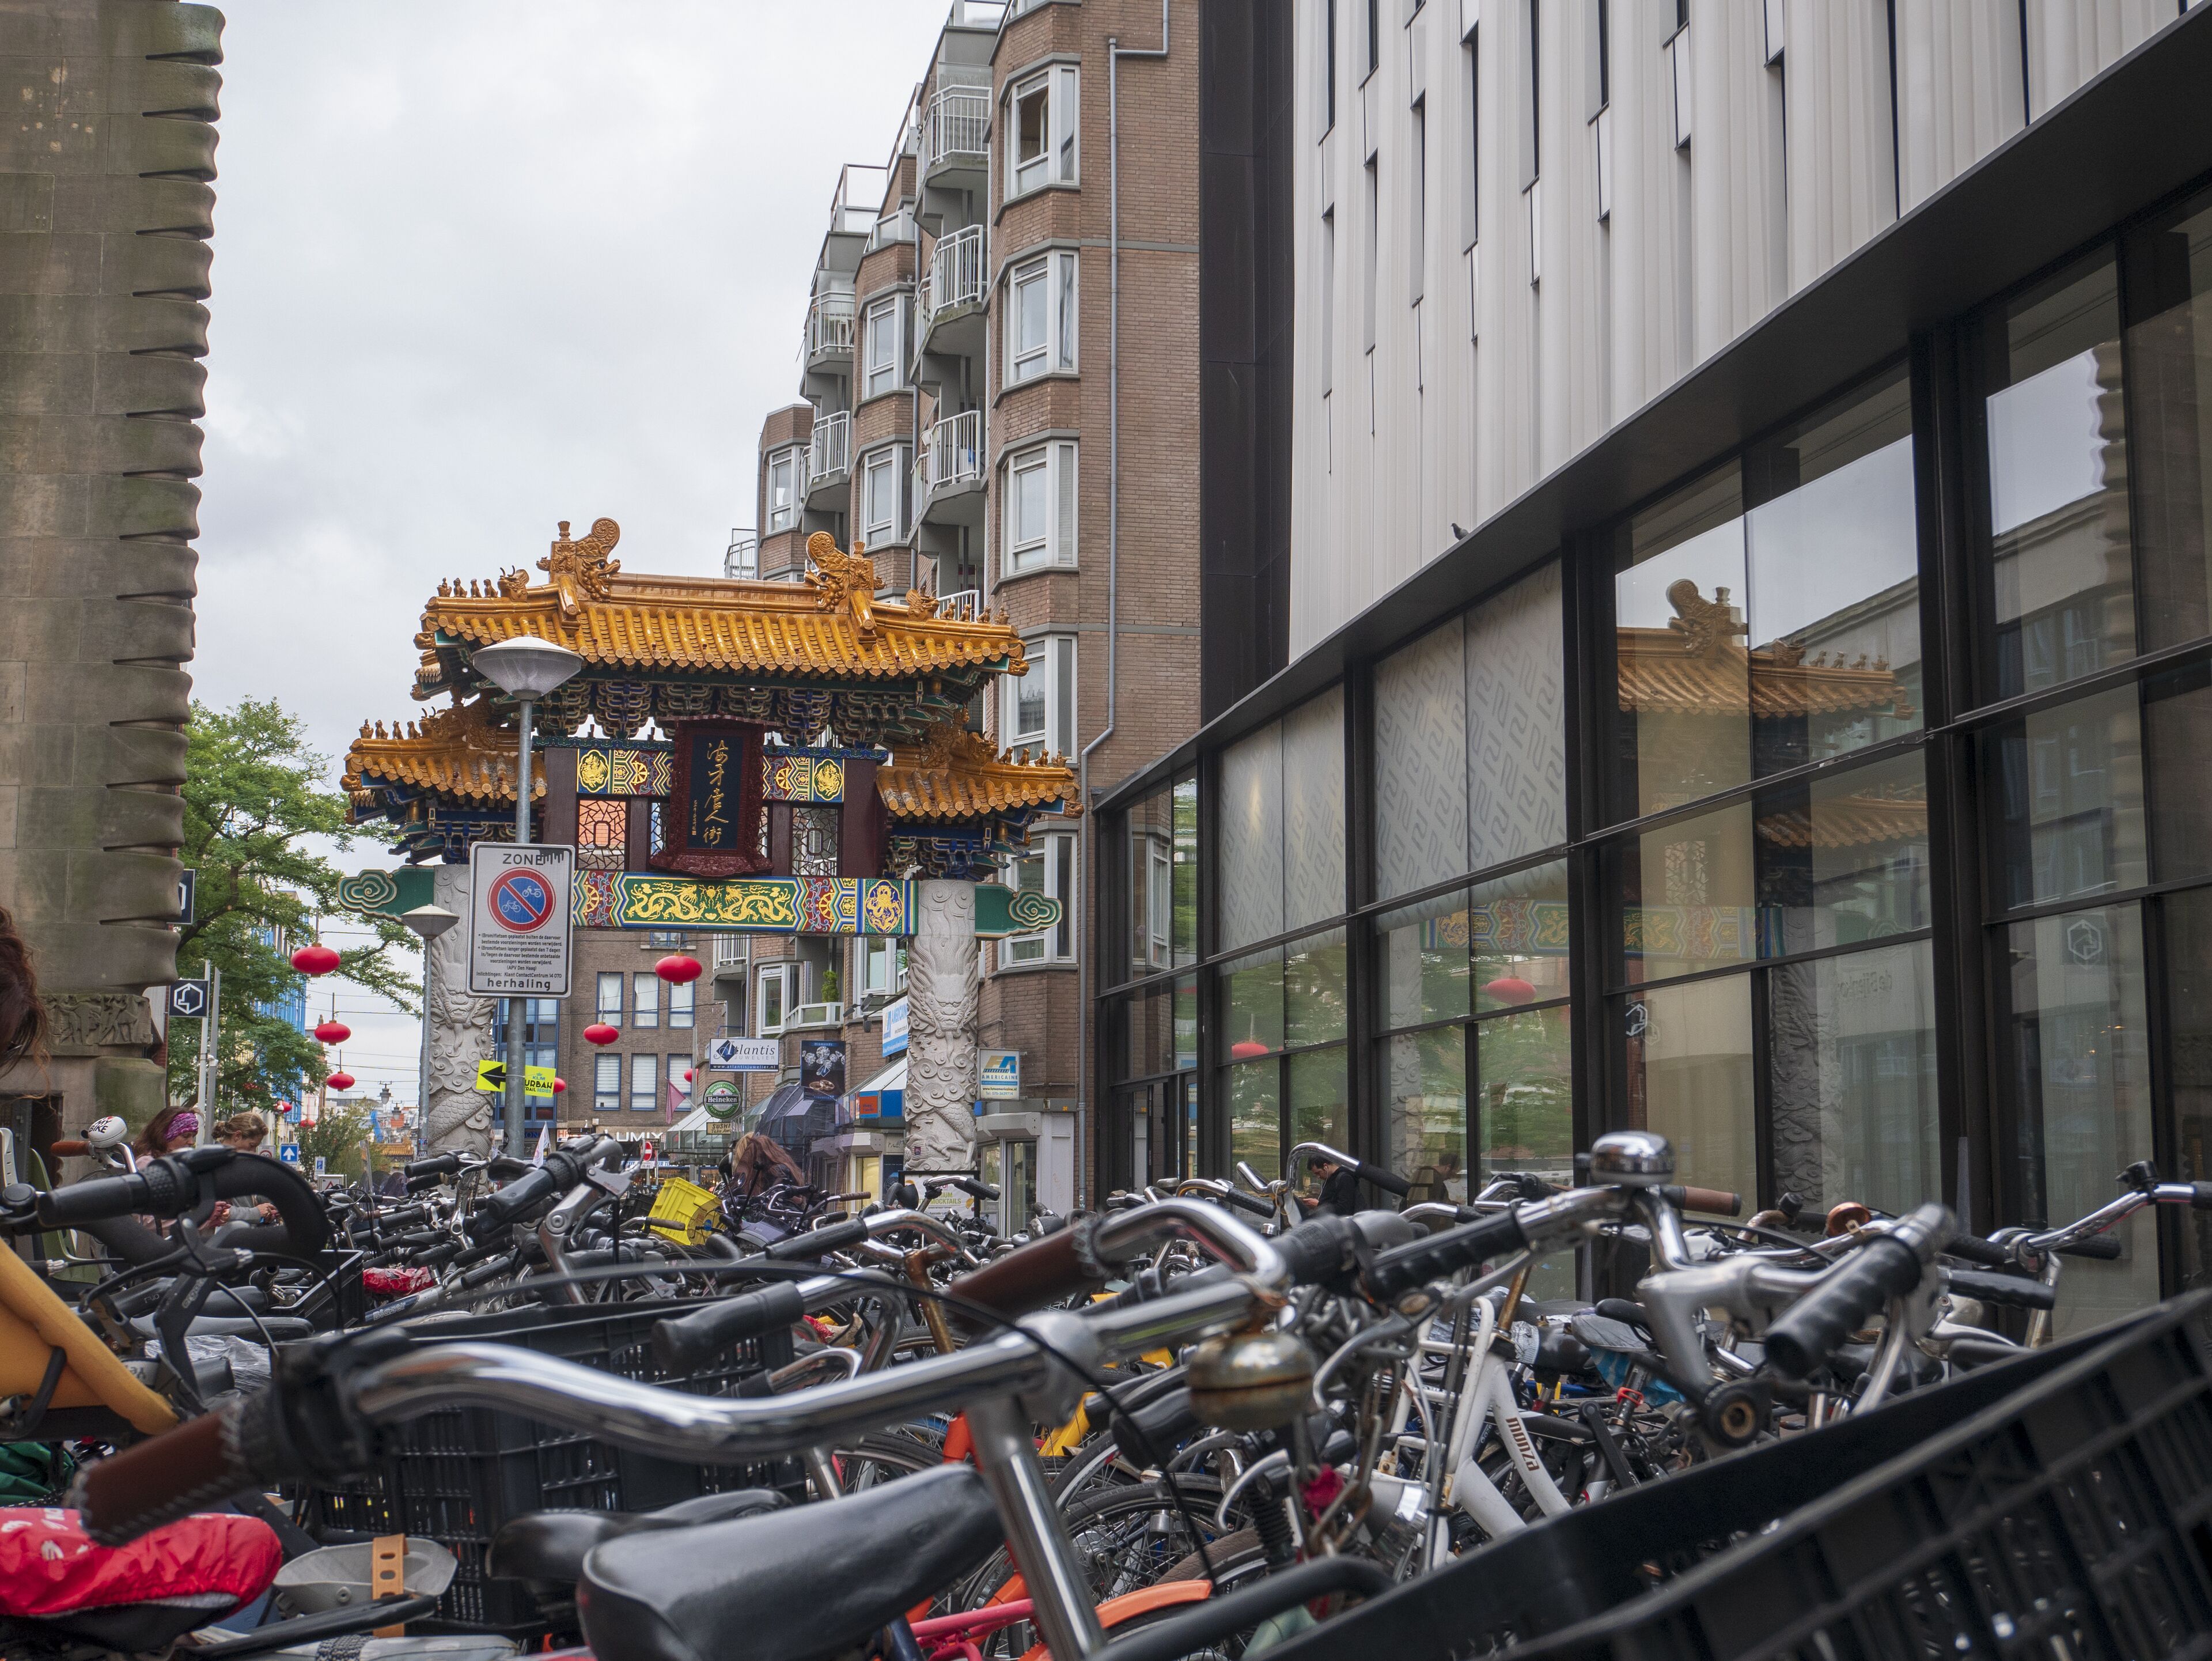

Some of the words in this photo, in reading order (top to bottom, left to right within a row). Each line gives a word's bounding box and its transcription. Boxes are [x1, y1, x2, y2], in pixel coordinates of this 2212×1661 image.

[487, 978, 551, 992] herhaling
[713, 1041, 775, 1059] Atlantis
[525, 1079, 553, 1089] URBAN
[89, 1124, 108, 1133] BIKE
[373, 1302, 406, 1321] Blazer
